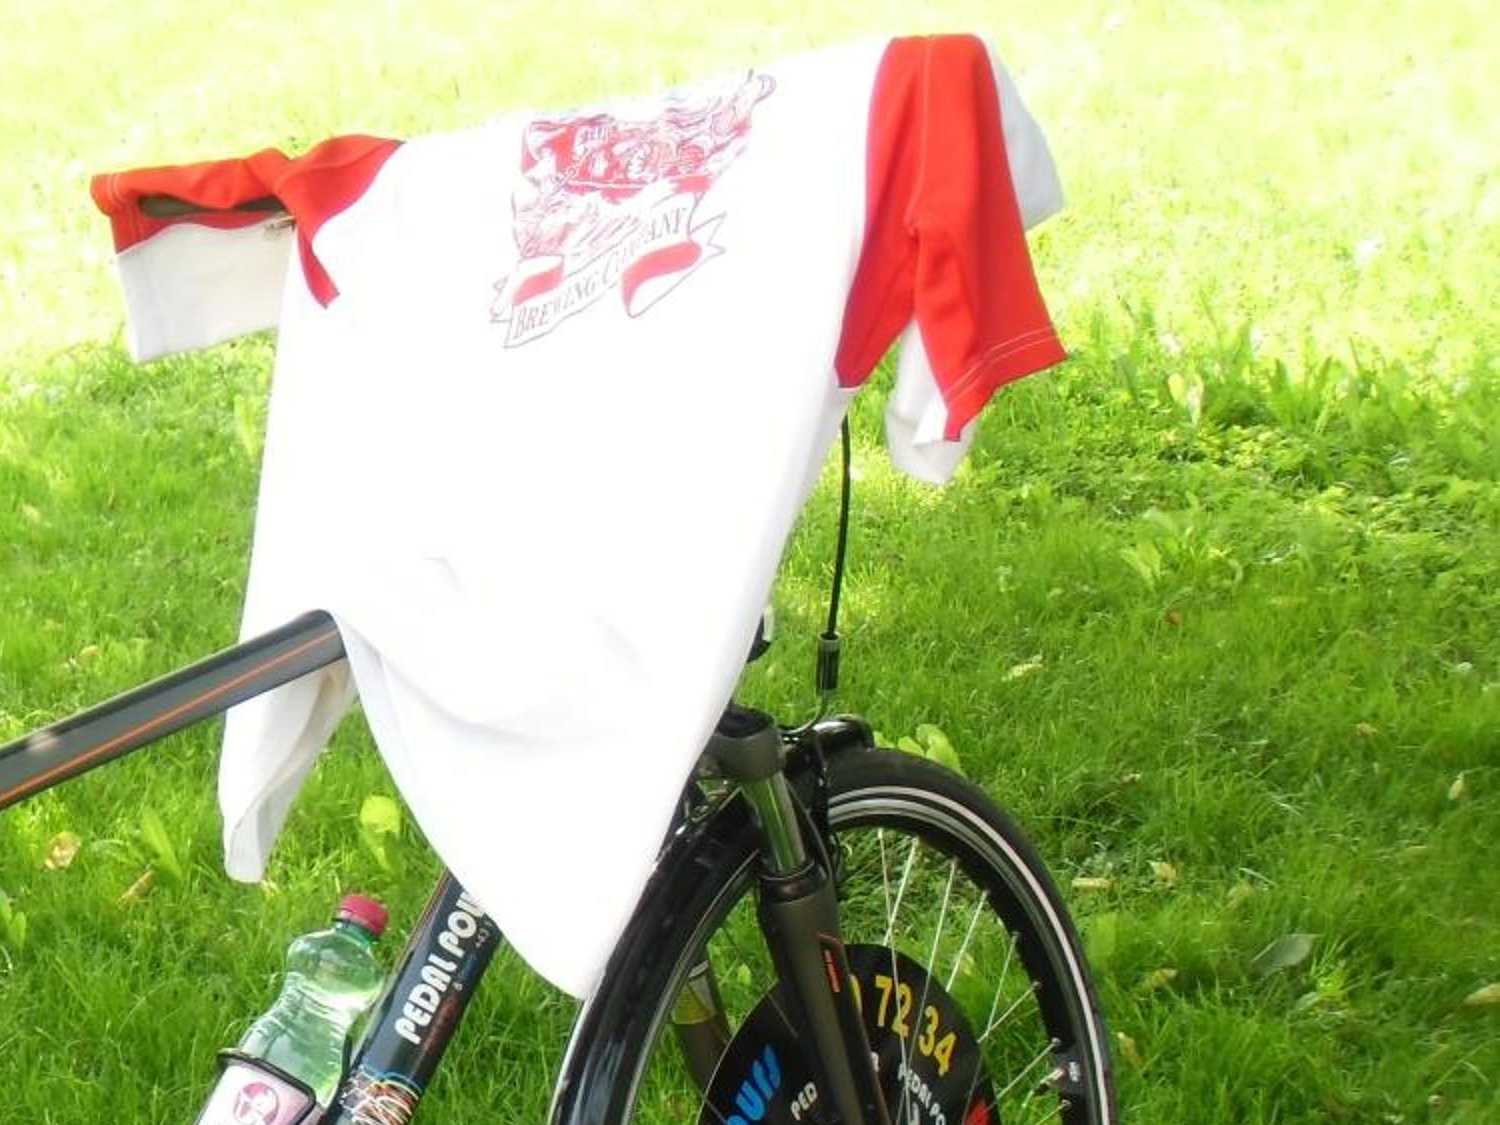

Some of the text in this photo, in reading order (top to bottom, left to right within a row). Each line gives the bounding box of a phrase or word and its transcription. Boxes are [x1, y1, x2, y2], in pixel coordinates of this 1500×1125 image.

[395, 890, 485, 1045] PEDAL POW
[875, 974, 912, 1038] 72
[918, 1005, 957, 1076] 34
[790, 1081, 819, 1121] PED
[897, 1061, 932, 1109] PEDAL
